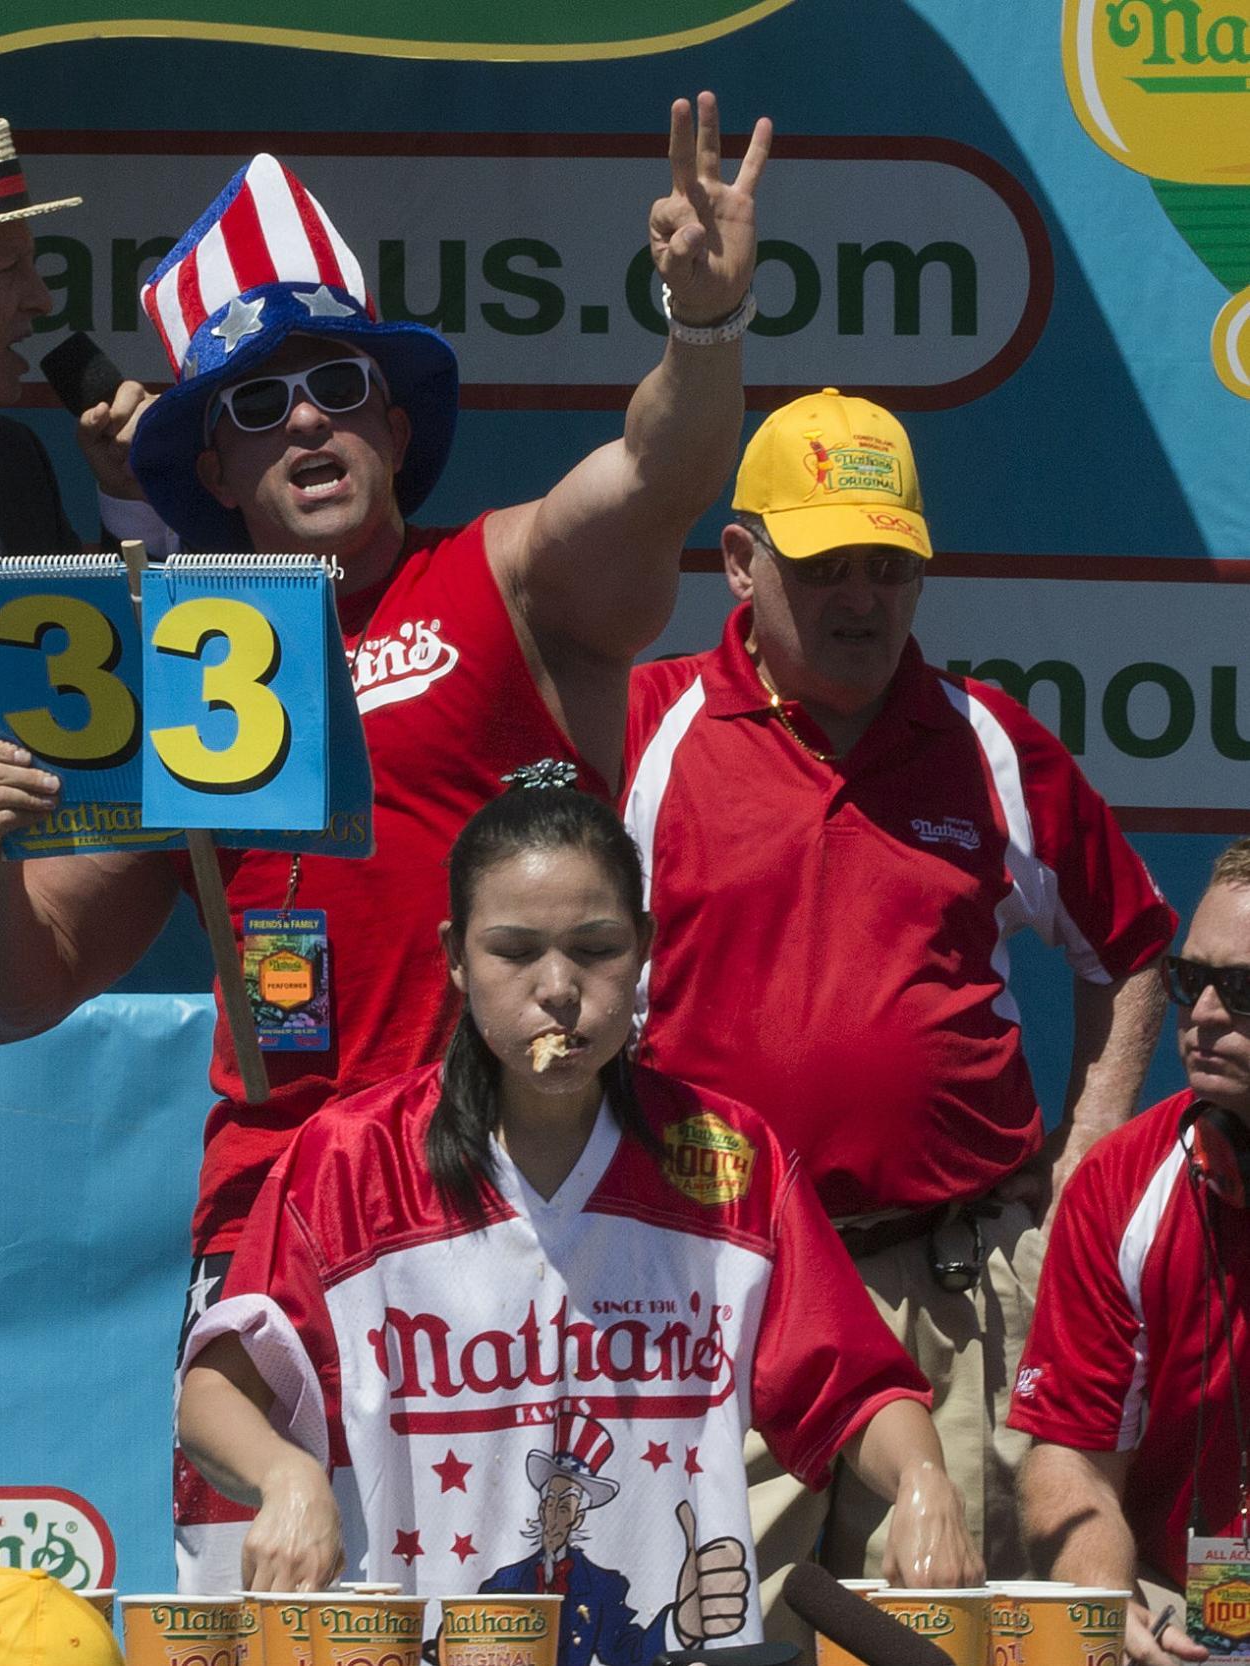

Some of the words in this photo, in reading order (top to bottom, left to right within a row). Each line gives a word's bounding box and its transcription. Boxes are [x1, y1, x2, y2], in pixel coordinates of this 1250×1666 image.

[838, 476, 895, 489] ORIGINAL
[249, 920, 283, 930] FRIENDS
[291, 920, 319, 930] FAMILY
[267, 982, 308, 990] PERFORMER
[593, 1299, 645, 1314] SINCE
[367, 1291, 734, 1398] Nathan's
[1205, 1551, 1227, 1560] ALL
